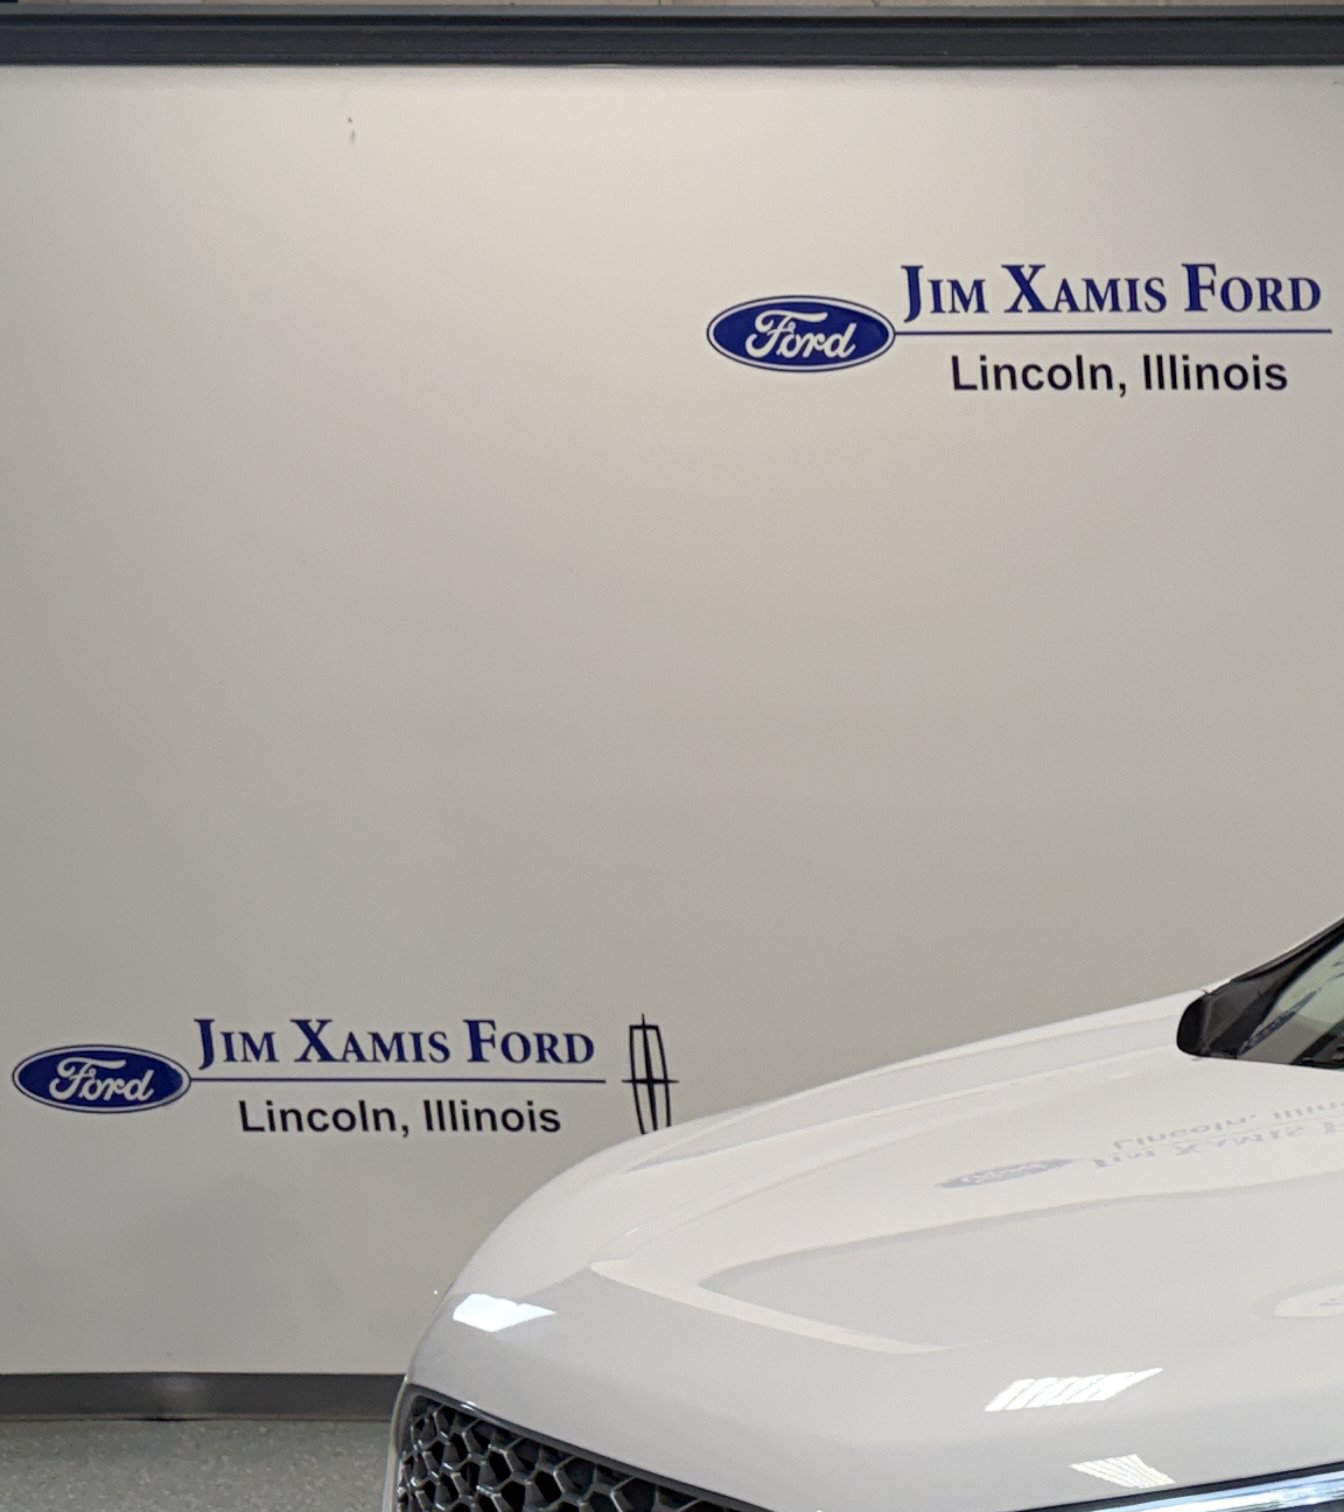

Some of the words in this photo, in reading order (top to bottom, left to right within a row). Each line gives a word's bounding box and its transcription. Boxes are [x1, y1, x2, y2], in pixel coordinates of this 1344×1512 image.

[900, 265, 989, 324] JIM
[1001, 264, 1167, 314] XAMIS
[1181, 263, 1321, 313] FORD
[744, 308, 858, 359] Ford
[951, 354, 1127, 398] Lincoln,
[1143, 354, 1288, 391] Illinois
[193, 1018, 279, 1071] JIM
[290, 1018, 451, 1064] XAMIS
[463, 1019, 595, 1064] FORD
[48, 1054, 156, 1103] Ford
[238, 1099, 409, 1138] Lincoln,
[423, 1099, 561, 1133] Illinois
